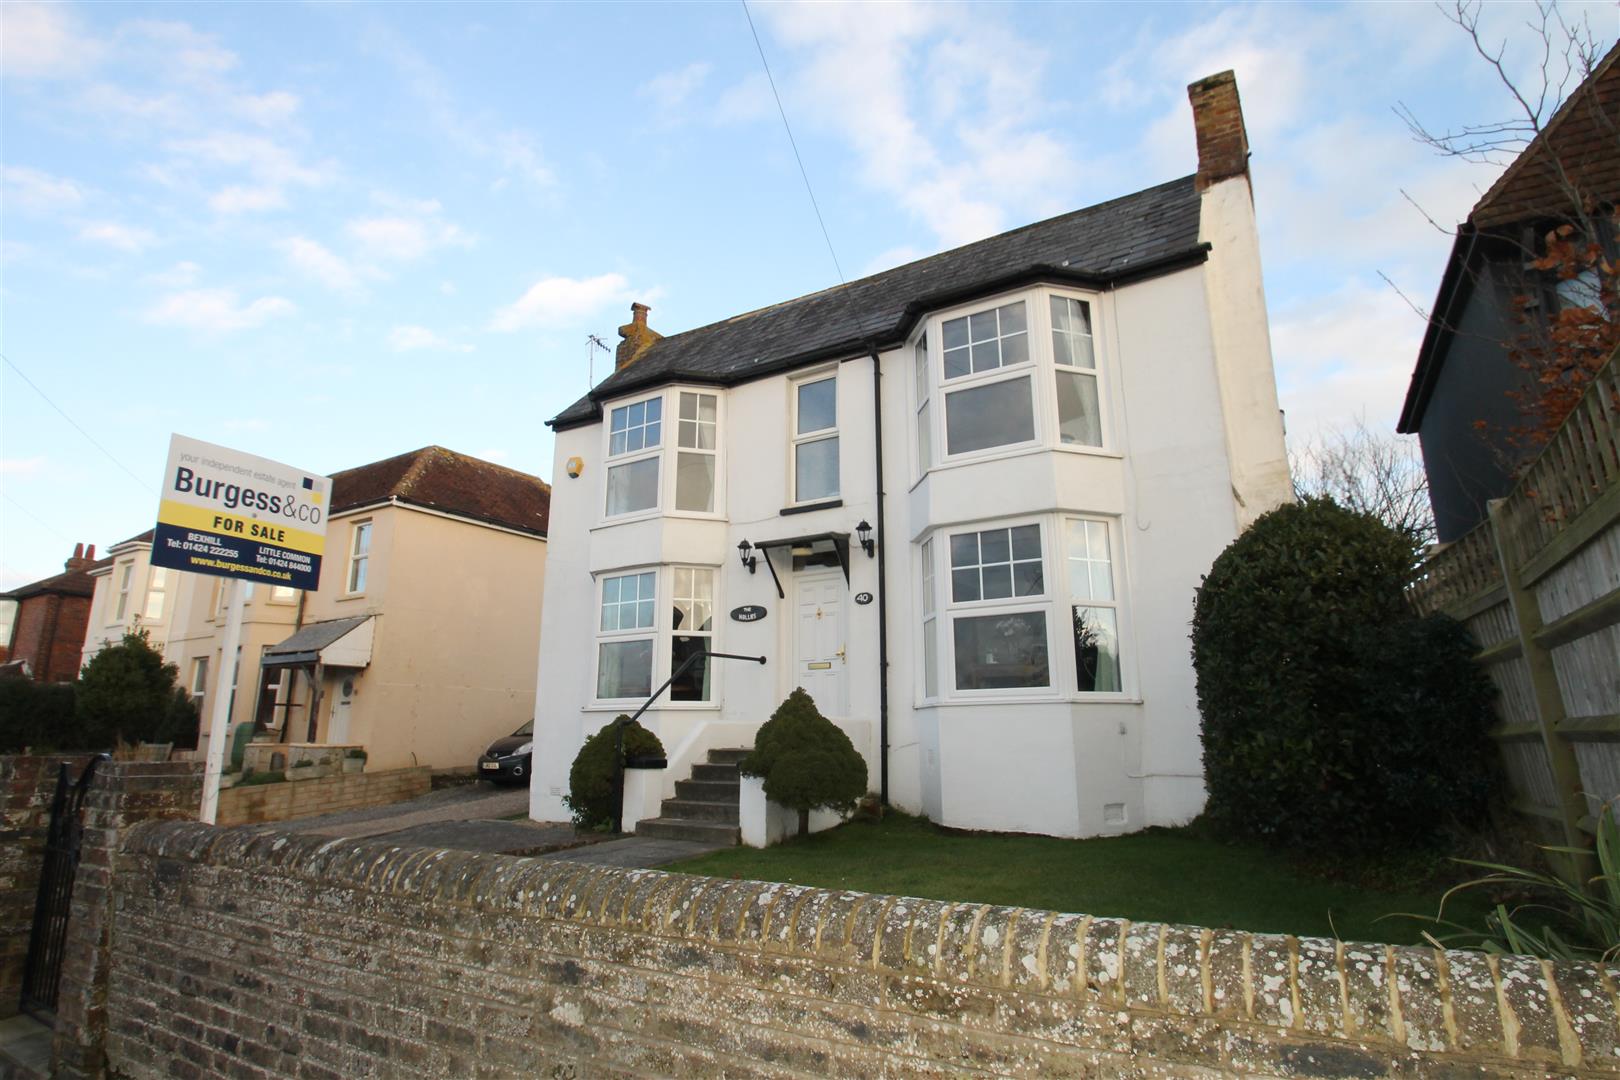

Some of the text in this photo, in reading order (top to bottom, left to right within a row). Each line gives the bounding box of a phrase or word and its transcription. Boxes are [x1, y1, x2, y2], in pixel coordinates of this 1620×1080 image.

[180, 452, 297, 490] your independent estate agent
[213, 516, 286, 542] FOR SALE
[167, 538, 181, 549] Tel:
[183, 541, 208, 553] 01424
[188, 533, 222, 546] BEXHILL
[256, 555, 267, 565] Tel:
[268, 557, 288, 568] 01424
[259, 546, 311, 564] LITTLE COMMON
[190, 556, 292, 580] www.burgessandco.co.uk
[856, 594, 869, 602] 40
